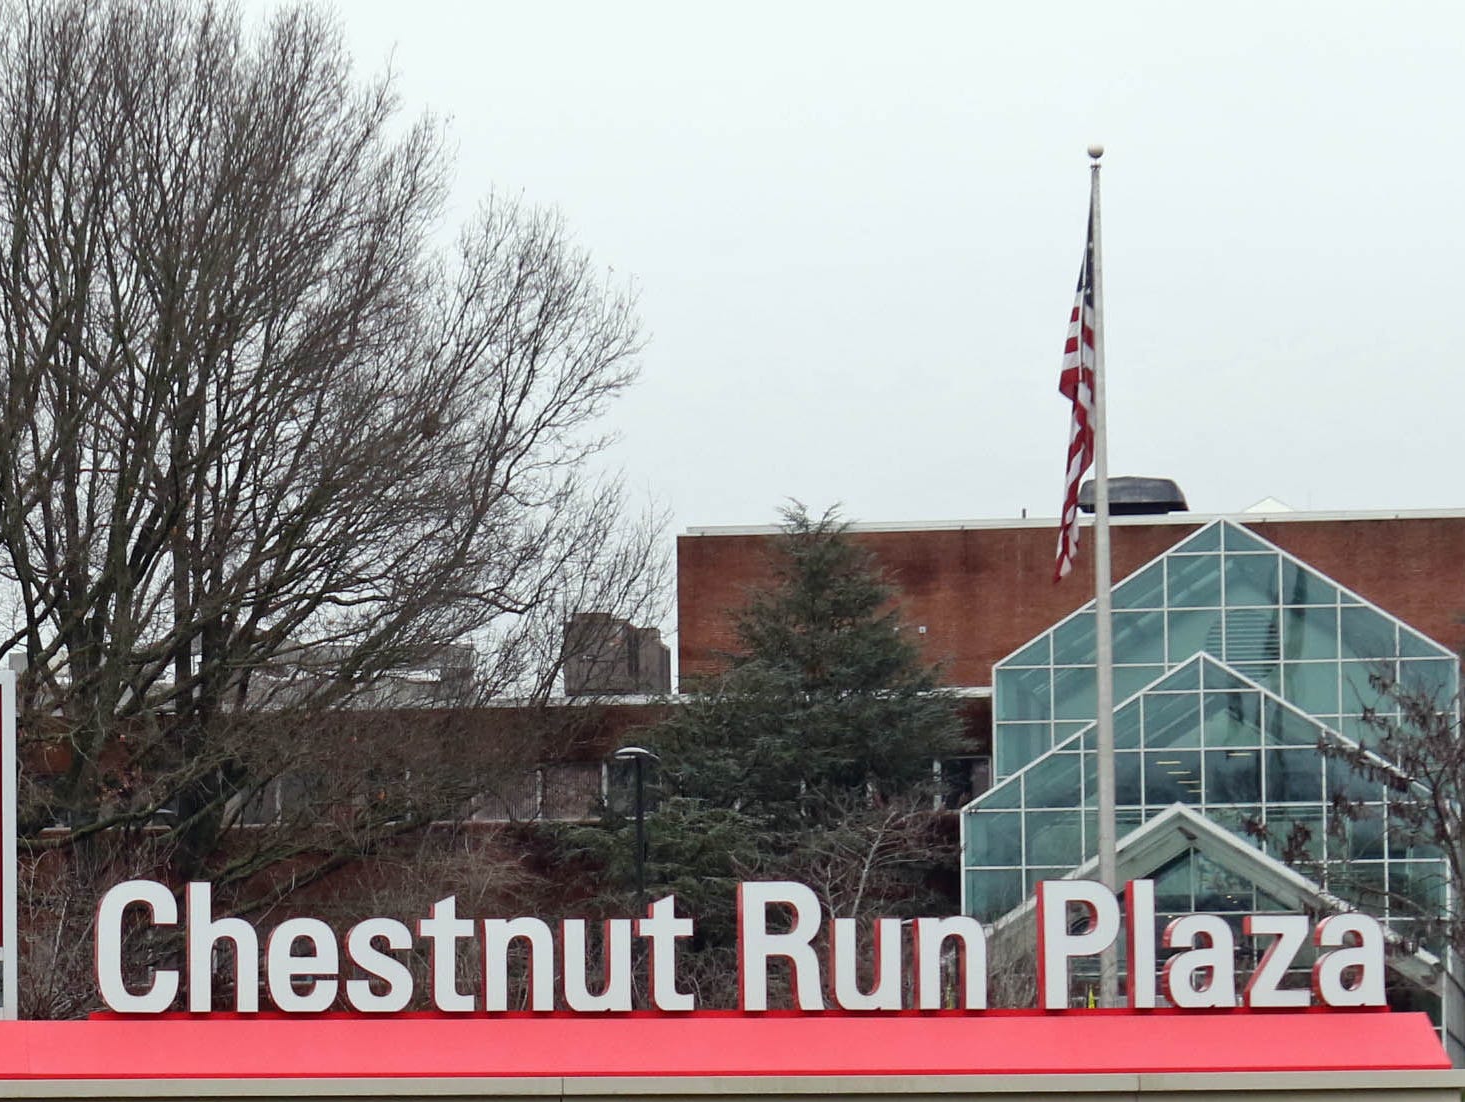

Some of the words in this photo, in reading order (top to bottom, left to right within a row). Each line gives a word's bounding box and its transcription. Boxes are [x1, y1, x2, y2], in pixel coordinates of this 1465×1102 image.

[95, 879, 694, 1013] Chestnut
[737, 880, 988, 1011] Run
[1037, 879, 1387, 1008] Plaza
